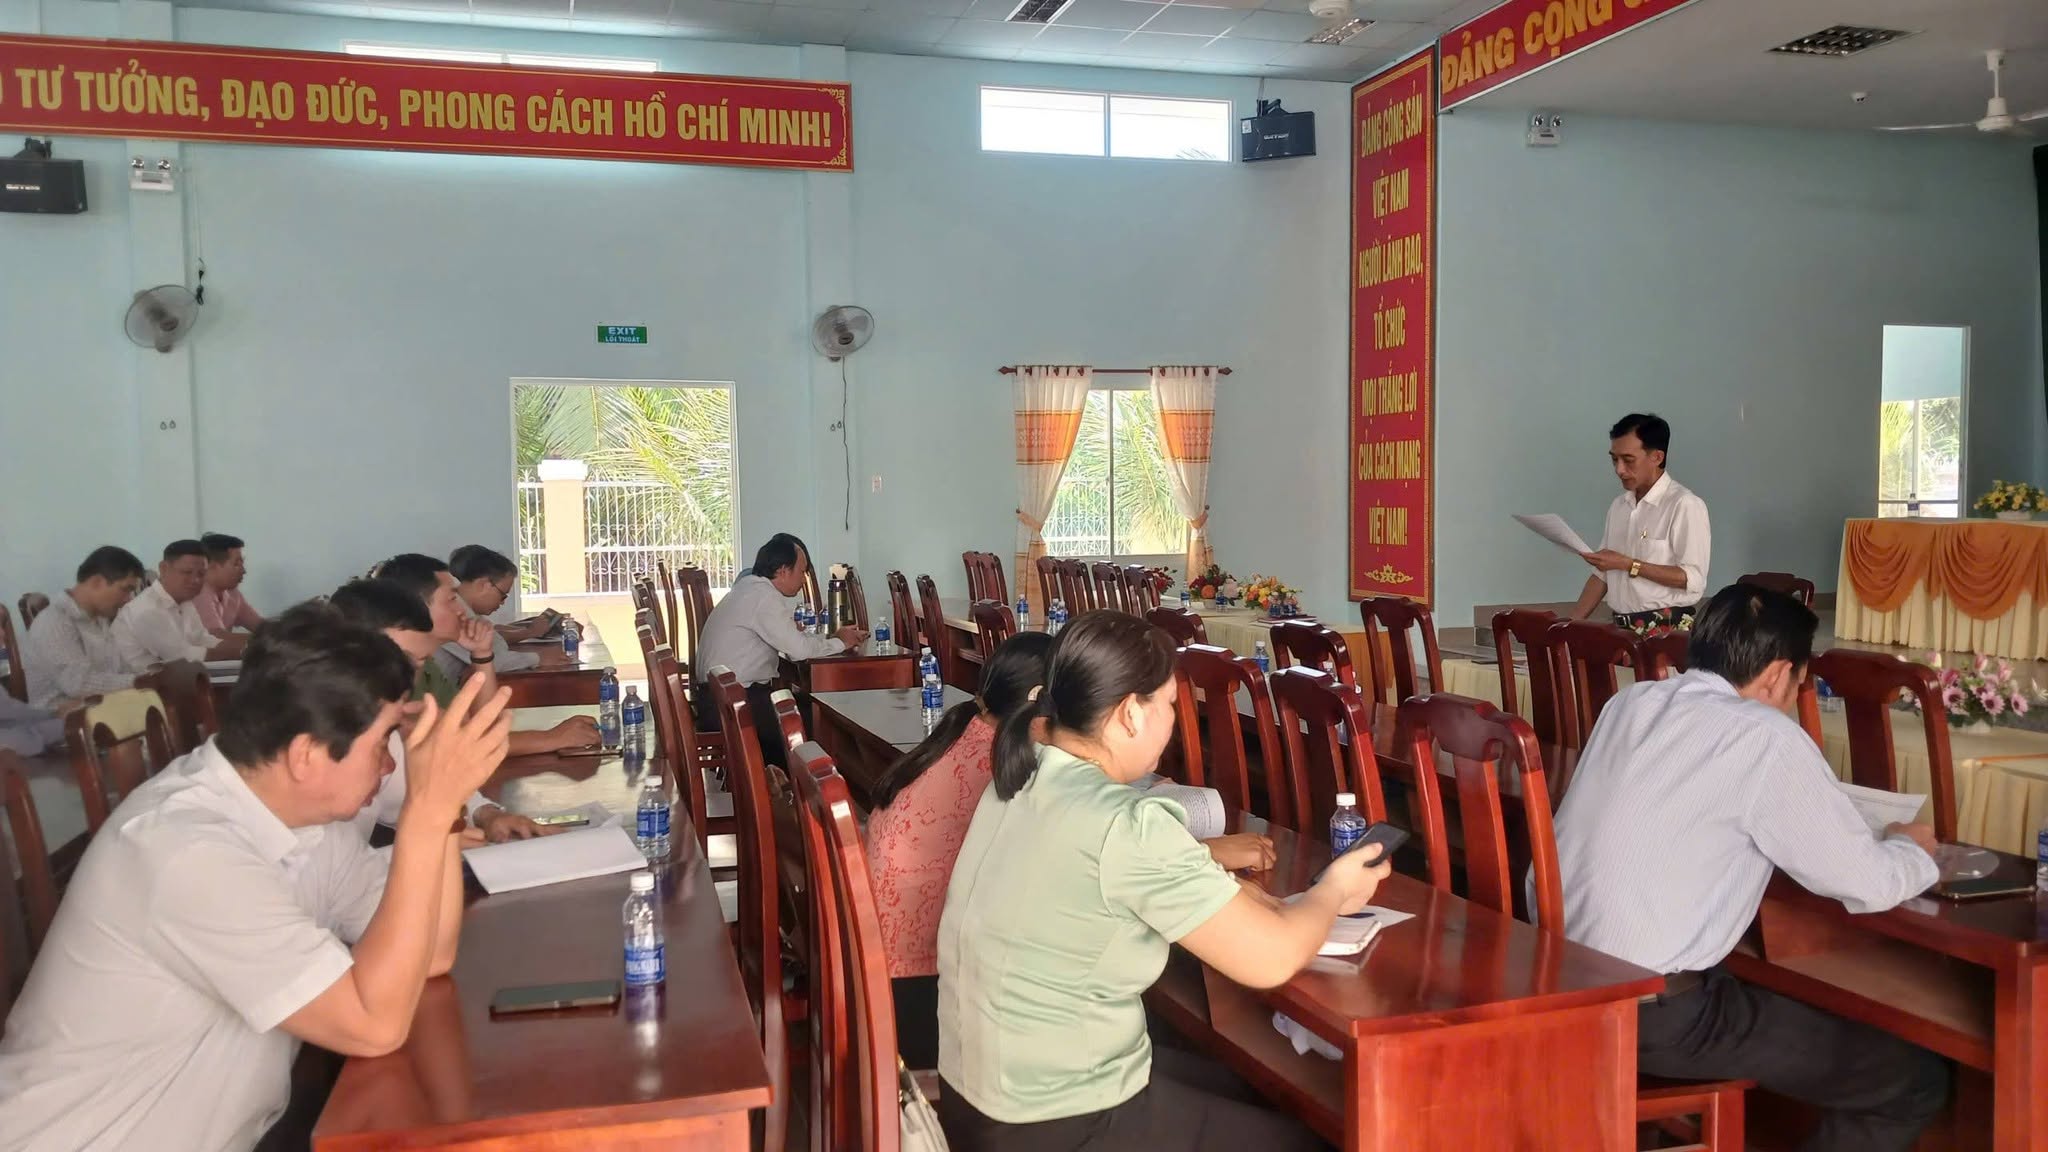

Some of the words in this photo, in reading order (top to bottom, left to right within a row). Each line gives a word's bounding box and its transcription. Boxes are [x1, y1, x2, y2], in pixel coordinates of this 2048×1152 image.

[1441, 27, 1515, 94] ĐẢNG
[15, 64, 65, 110] TƯ
[74, 59, 210, 122] TƯỞNG,
[221, 78, 294, 128] ĐẠO
[305, 77, 389, 131] ĐỨC,
[400, 89, 516, 133] PHONG
[526, 88, 614, 137] CÁCH
[624, 90, 667, 140] HỒ
[677, 98, 729, 142] CHÍ
[739, 107, 832, 148] MINH!
[1361, 102, 1382, 158] ĐẢNG
[1382, 98, 1404, 155] CỘNG
[1405, 79, 1423, 140] SẢN
[1372, 169, 1390, 225] VIỆT
[1391, 168, 1409, 212] NAM
[1358, 238, 1382, 289] NGƯỜI
[1382, 234, 1403, 281] LÃNH
[608, 327, 637, 335] EXIT
[1373, 295, 1384, 350] TỔ
[1384, 299, 1406, 348] CHỨC
[1361, 379, 1377, 425] MỌI
[1378, 360, 1404, 415] THẮNG
[1404, 366, 1417, 421] LỢI
[1358, 428, 1373, 481] CỦA
[1375, 433, 1396, 480] CÁCH
[1396, 439, 1421, 488] MẠNG
[1368, 498, 1385, 552] VIỆT
